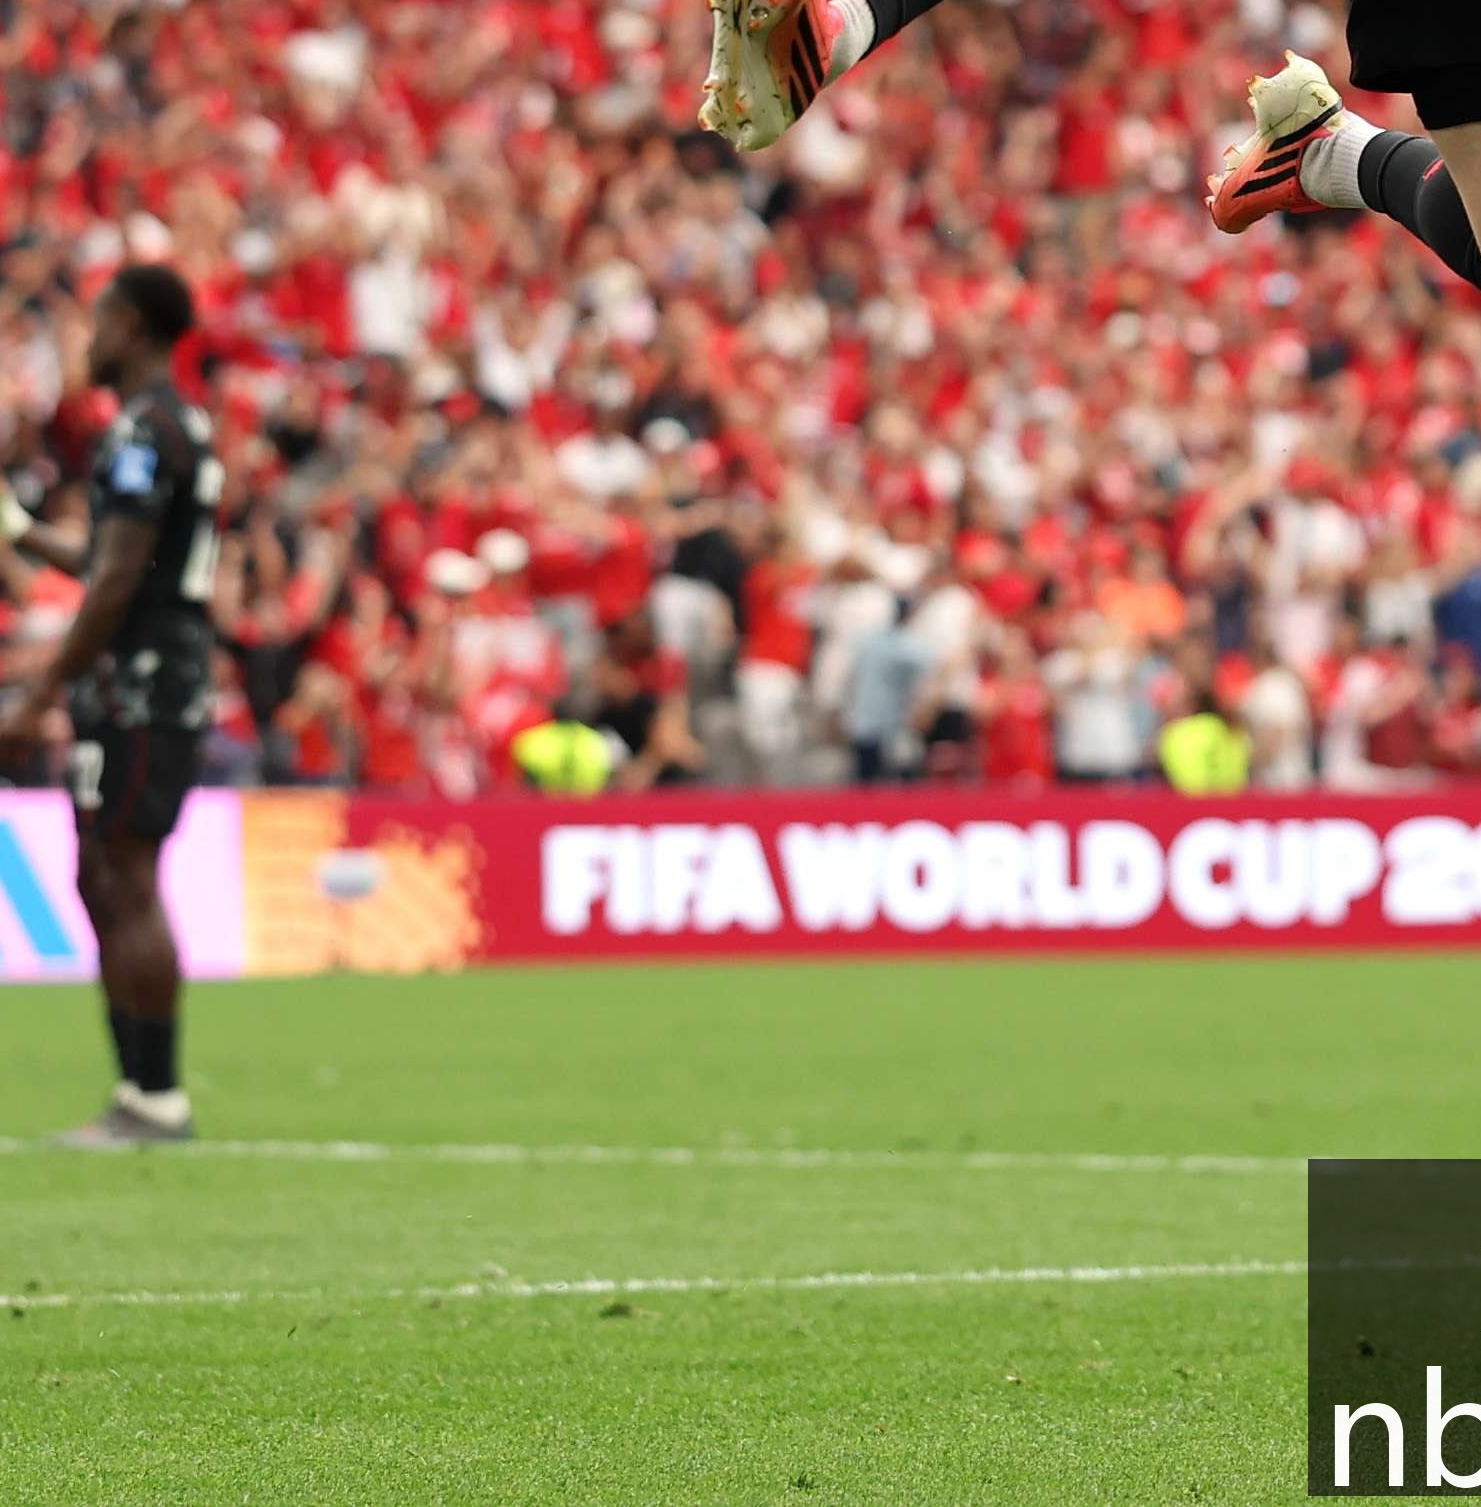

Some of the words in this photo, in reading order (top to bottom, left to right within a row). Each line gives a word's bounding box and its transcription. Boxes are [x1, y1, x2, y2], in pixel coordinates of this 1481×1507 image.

[540, 822, 783, 935] FIFA
[776, 818, 1166, 933] WORLD
[1166, 815, 1382, 929] CUP
